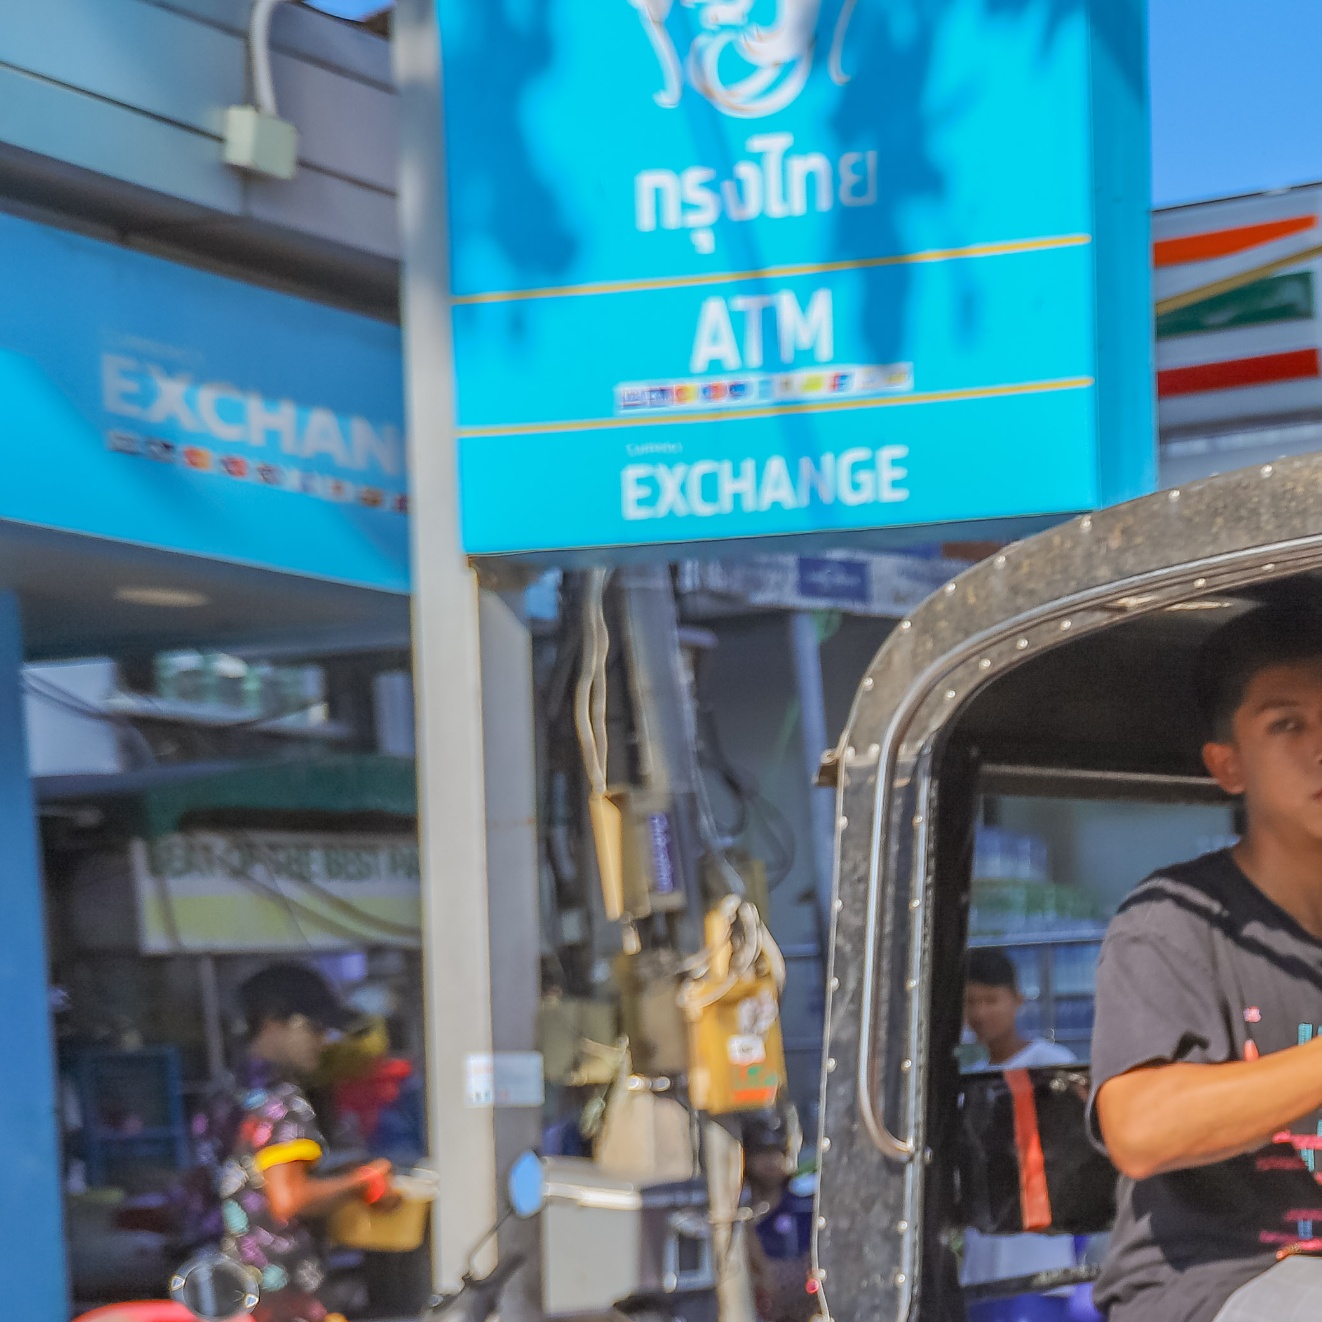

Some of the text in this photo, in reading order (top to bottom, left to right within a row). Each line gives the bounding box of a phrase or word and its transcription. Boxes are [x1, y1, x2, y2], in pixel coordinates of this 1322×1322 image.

[633, 131, 878, 254] กรุงไทย
[689, 288, 834, 374] ATM
[102, 352, 404, 478] EXCHAN
[620, 444, 910, 521] EXCHANGE
